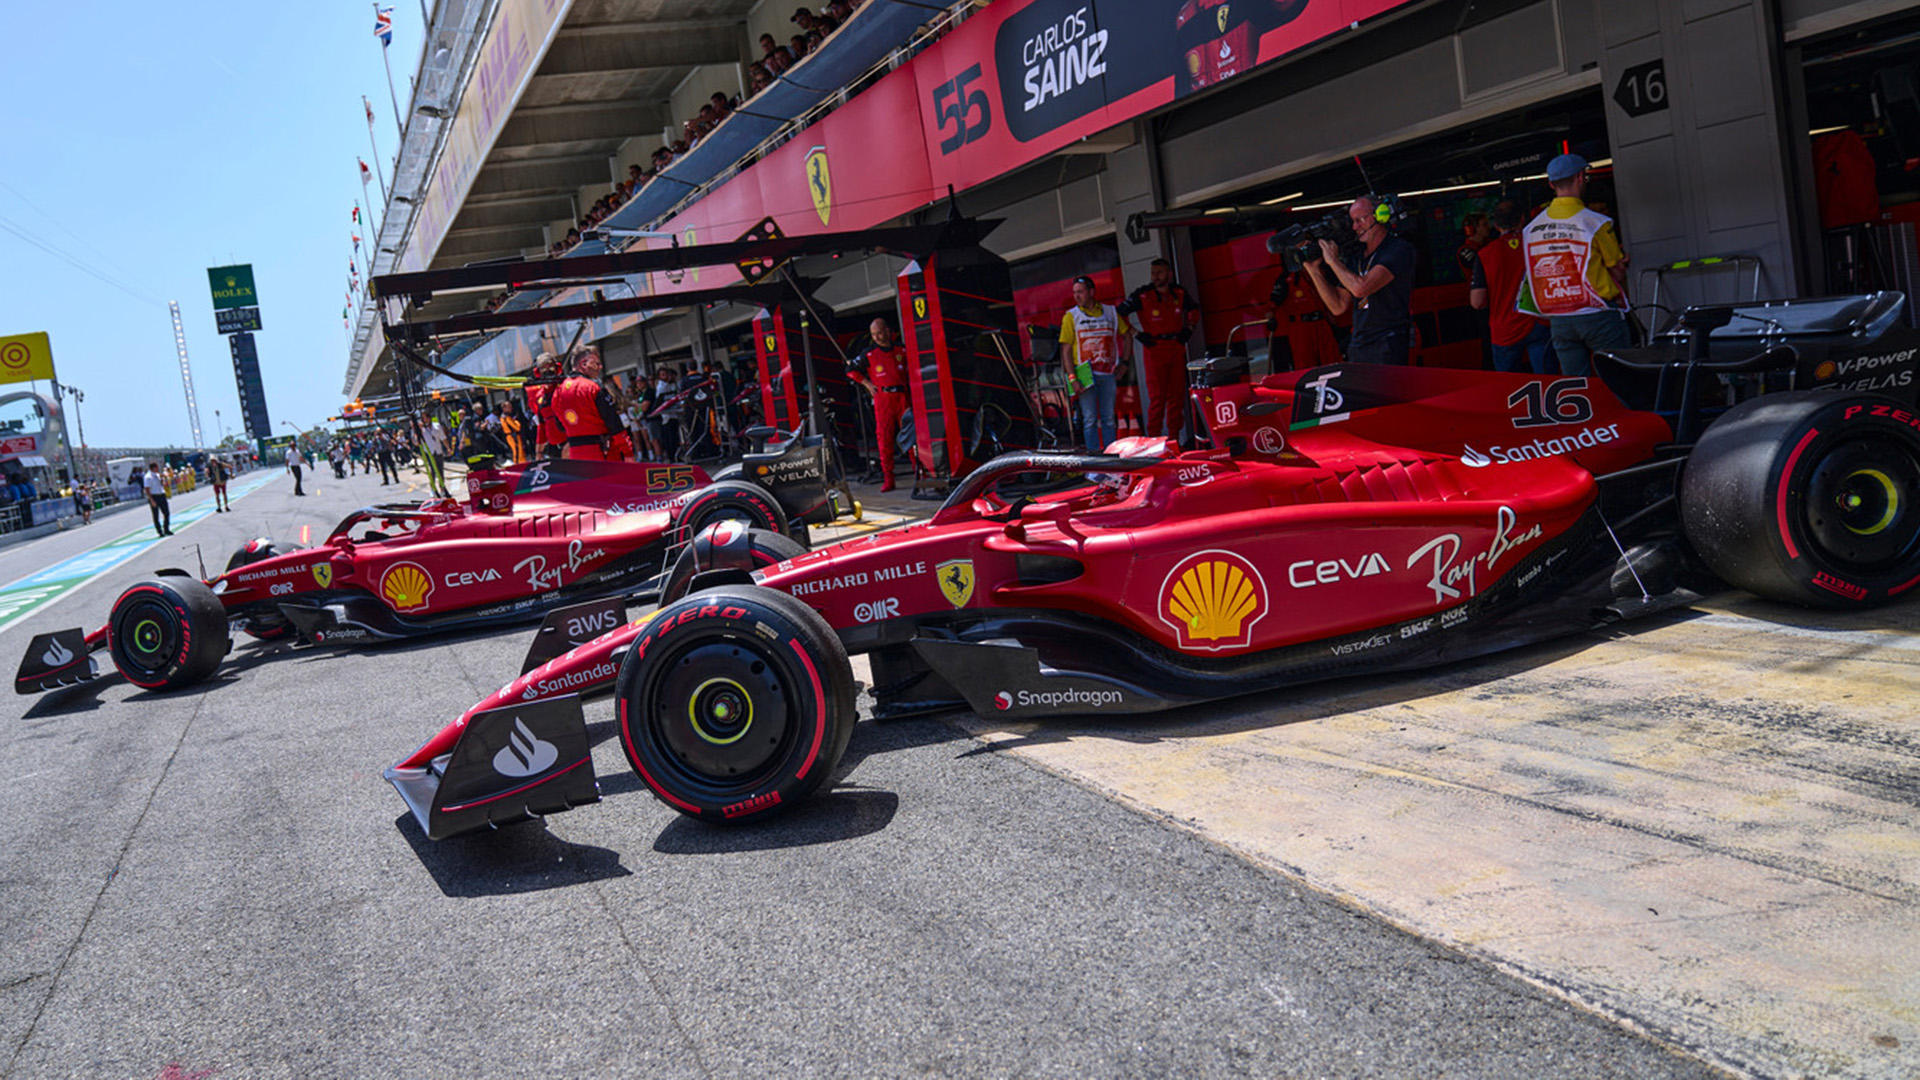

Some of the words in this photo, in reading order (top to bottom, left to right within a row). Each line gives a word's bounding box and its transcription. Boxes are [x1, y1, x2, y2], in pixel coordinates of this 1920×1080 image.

[1023, 7, 1087, 67] CARLOS
[1024, 29, 1108, 112] SAINZ
[1627, 69, 1665, 108] 16
[932, 62, 992, 156] 55
[213, 287, 253, 299] ROLEX
[1544, 285, 1582, 299] LANE
[1547, 276, 1571, 288] PIT
[1837, 348, 1917, 376] V-Power
[1508, 377, 1593, 428] 16
[1844, 405, 1863, 420] P
[1490, 424, 1619, 464] Santander
[768, 456, 815, 473] V-Power
[778, 468, 820, 482] VELAS
[1178, 463, 1211, 482] aws
[646, 465, 696, 495] 55
[749, 498, 779, 533] ZERO
[238, 569, 278, 583] RICHARD
[280, 564, 307, 576] MILLE
[791, 572, 868, 597] RICHARD
[874, 561, 927, 582] MILLE
[1517, 565, 1542, 588] brembo
[1812, 571, 1868, 601] PIRELLI
[326, 629, 366, 640] Snapdragon
[567, 609, 617, 637] aws
[638, 635, 651, 660] P
[658, 605, 747, 638] ZERO
[1400, 618, 1434, 639] SKF
[179, 617, 191, 665] ZERO
[538, 661, 617, 695] Santander
[1018, 688, 1123, 707] Snapdragon
[722, 790, 782, 819] PIRELLI
